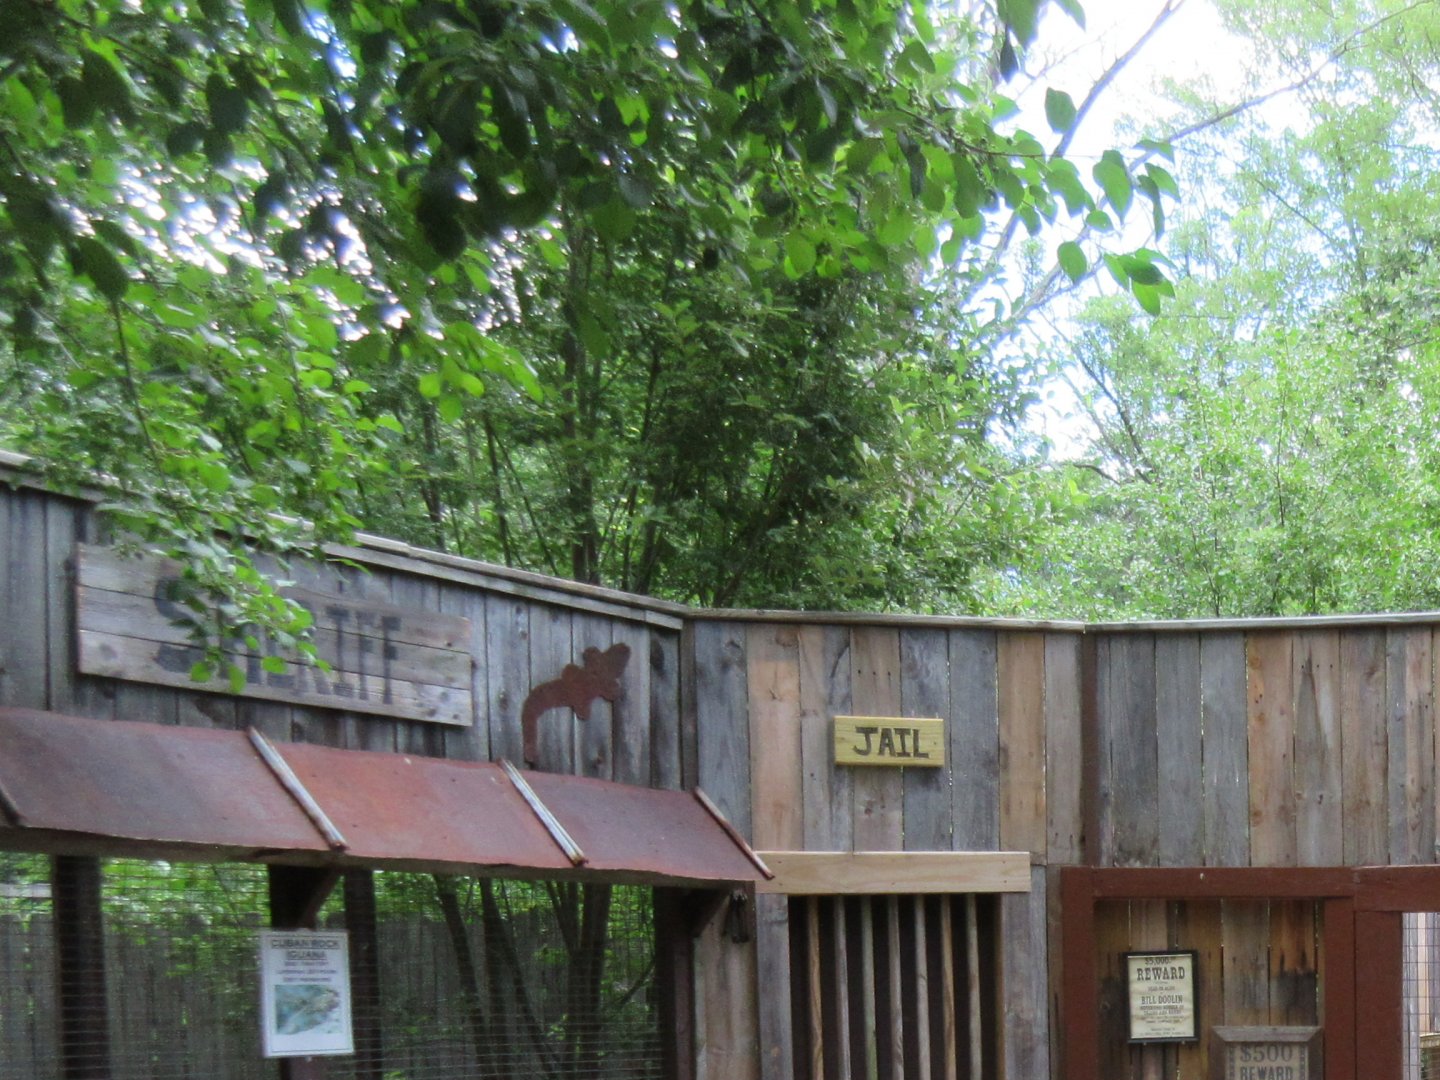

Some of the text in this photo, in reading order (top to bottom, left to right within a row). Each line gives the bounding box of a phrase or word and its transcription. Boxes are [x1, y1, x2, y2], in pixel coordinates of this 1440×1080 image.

[852, 726, 930, 759] JAIL
[1136, 966, 1186, 981] REWARD
[1141, 995, 1157, 1005] BILL
[1239, 1044, 1293, 1063] $500
